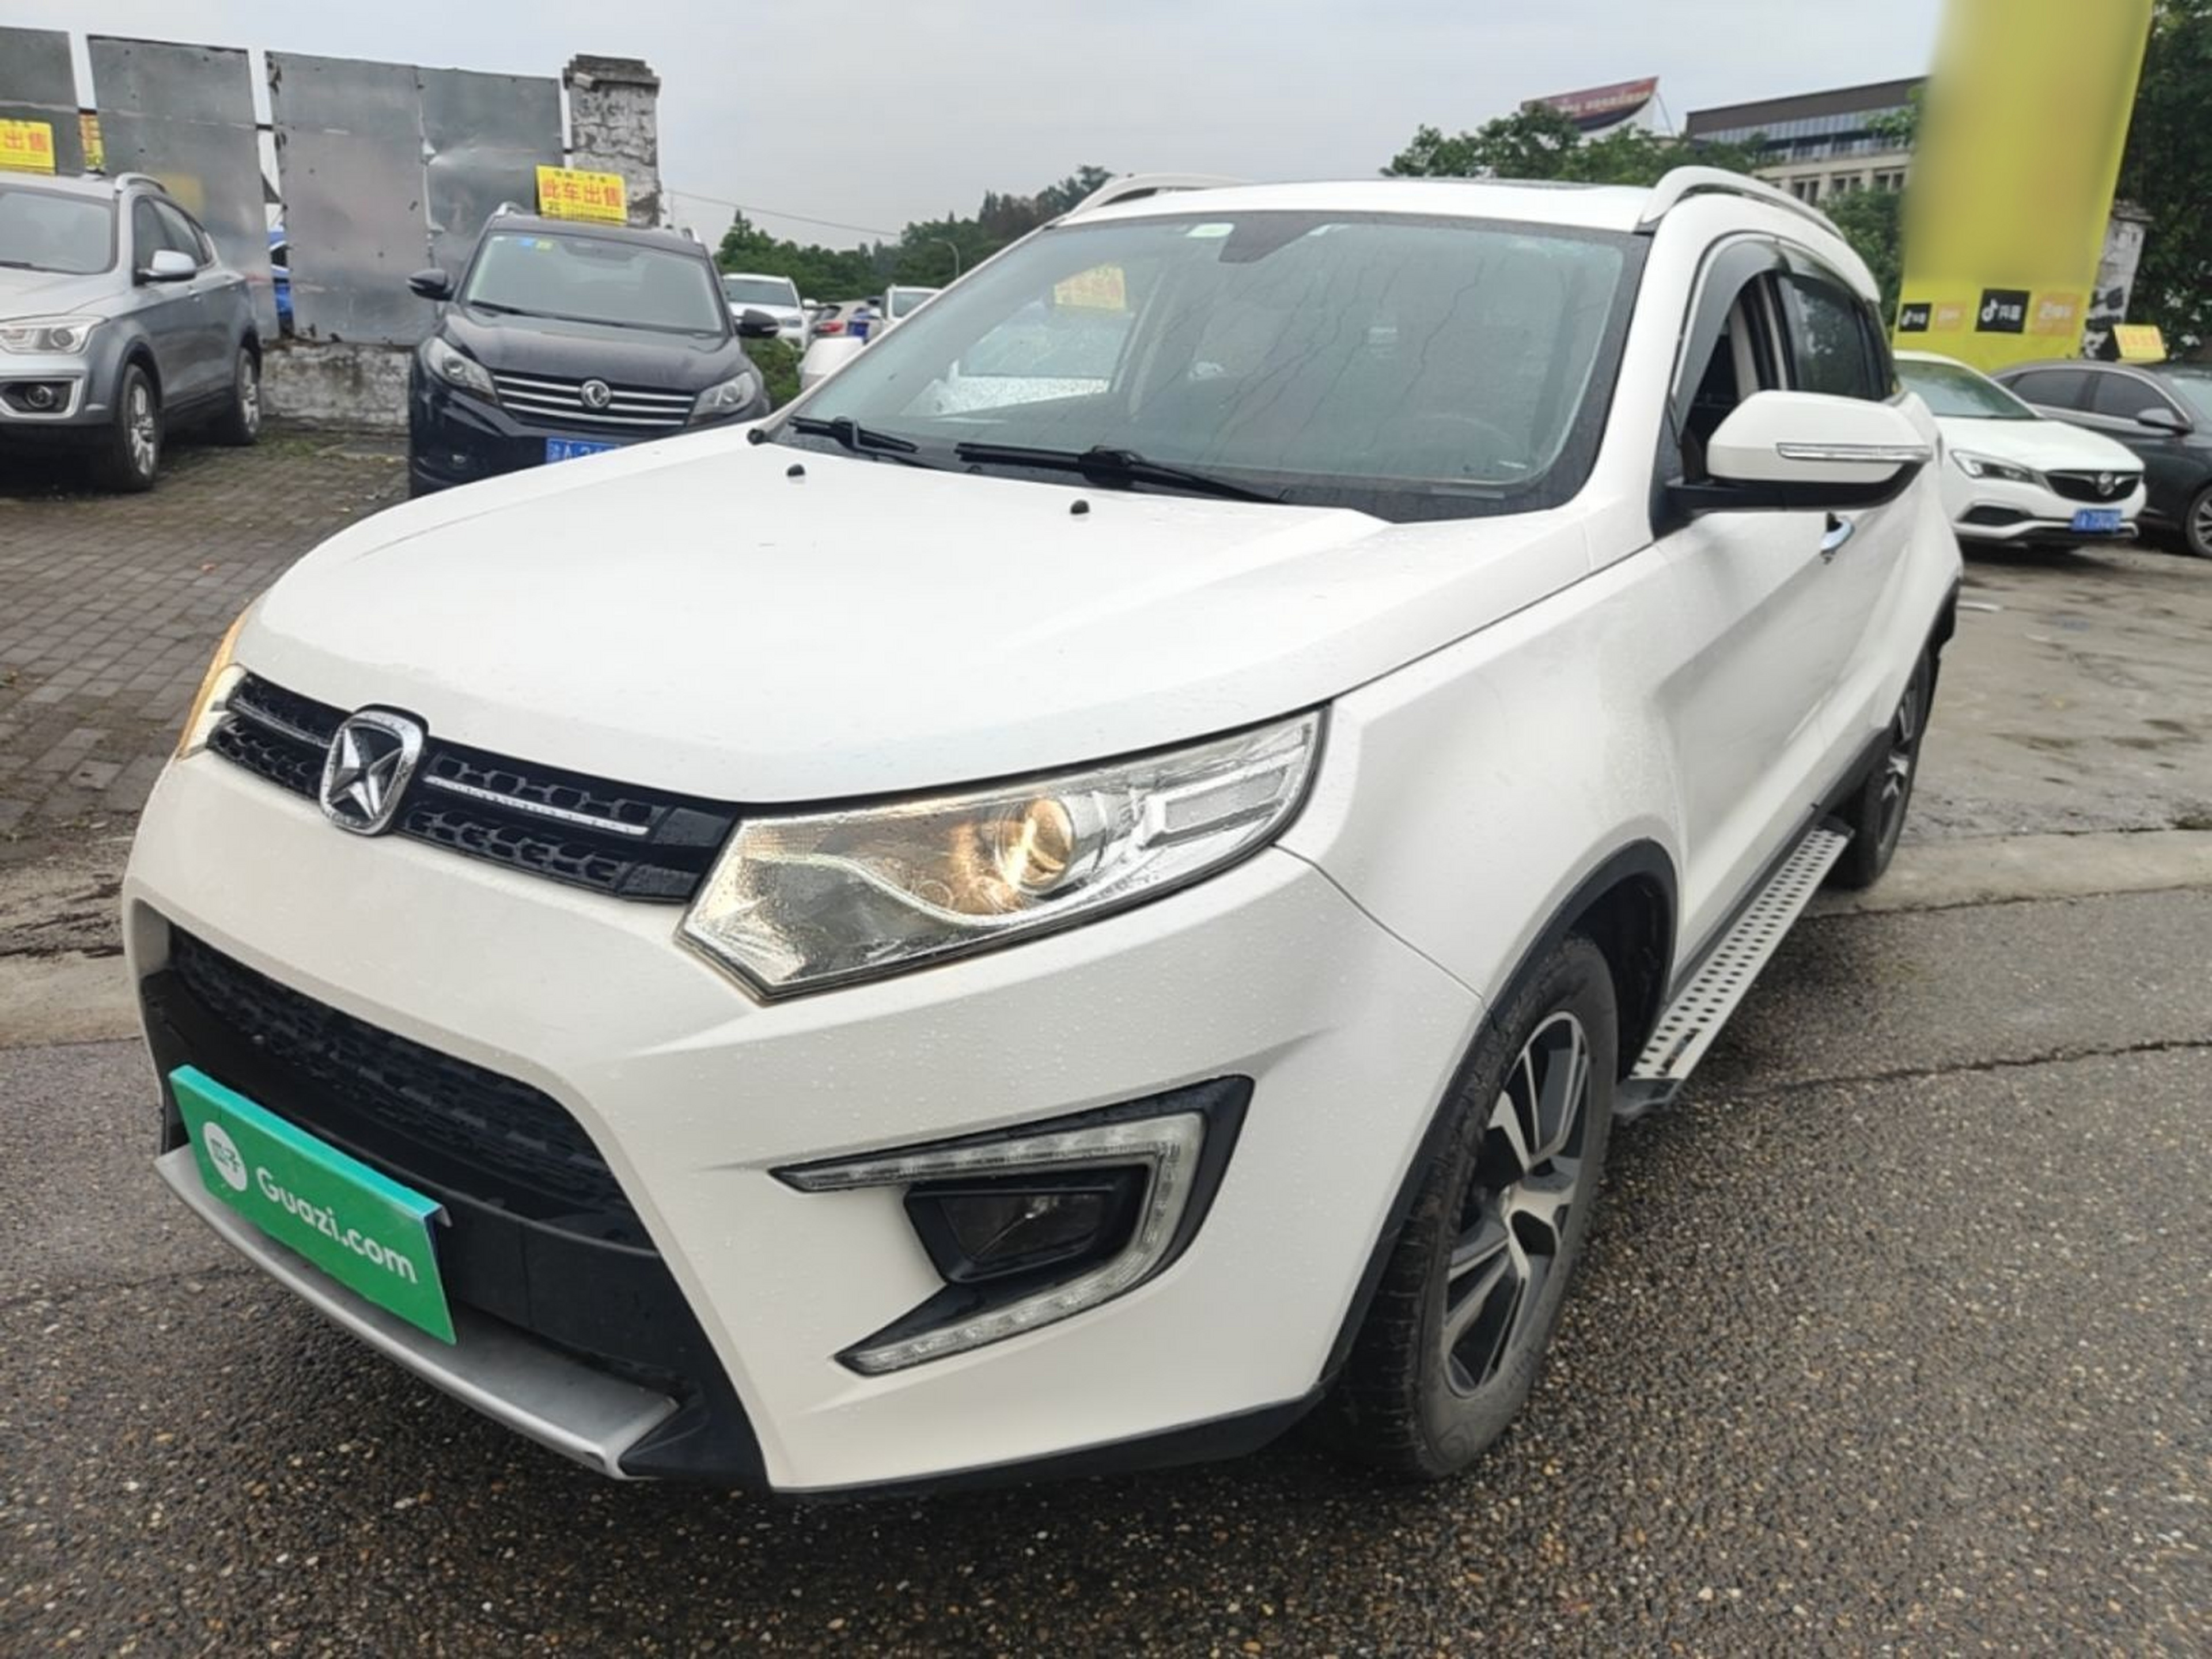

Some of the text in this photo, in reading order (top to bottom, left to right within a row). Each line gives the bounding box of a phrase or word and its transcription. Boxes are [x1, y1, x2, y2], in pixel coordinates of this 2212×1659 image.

[541, 178, 621, 208] 此车出售
[256, 1166, 418, 1284] Guazi.com
